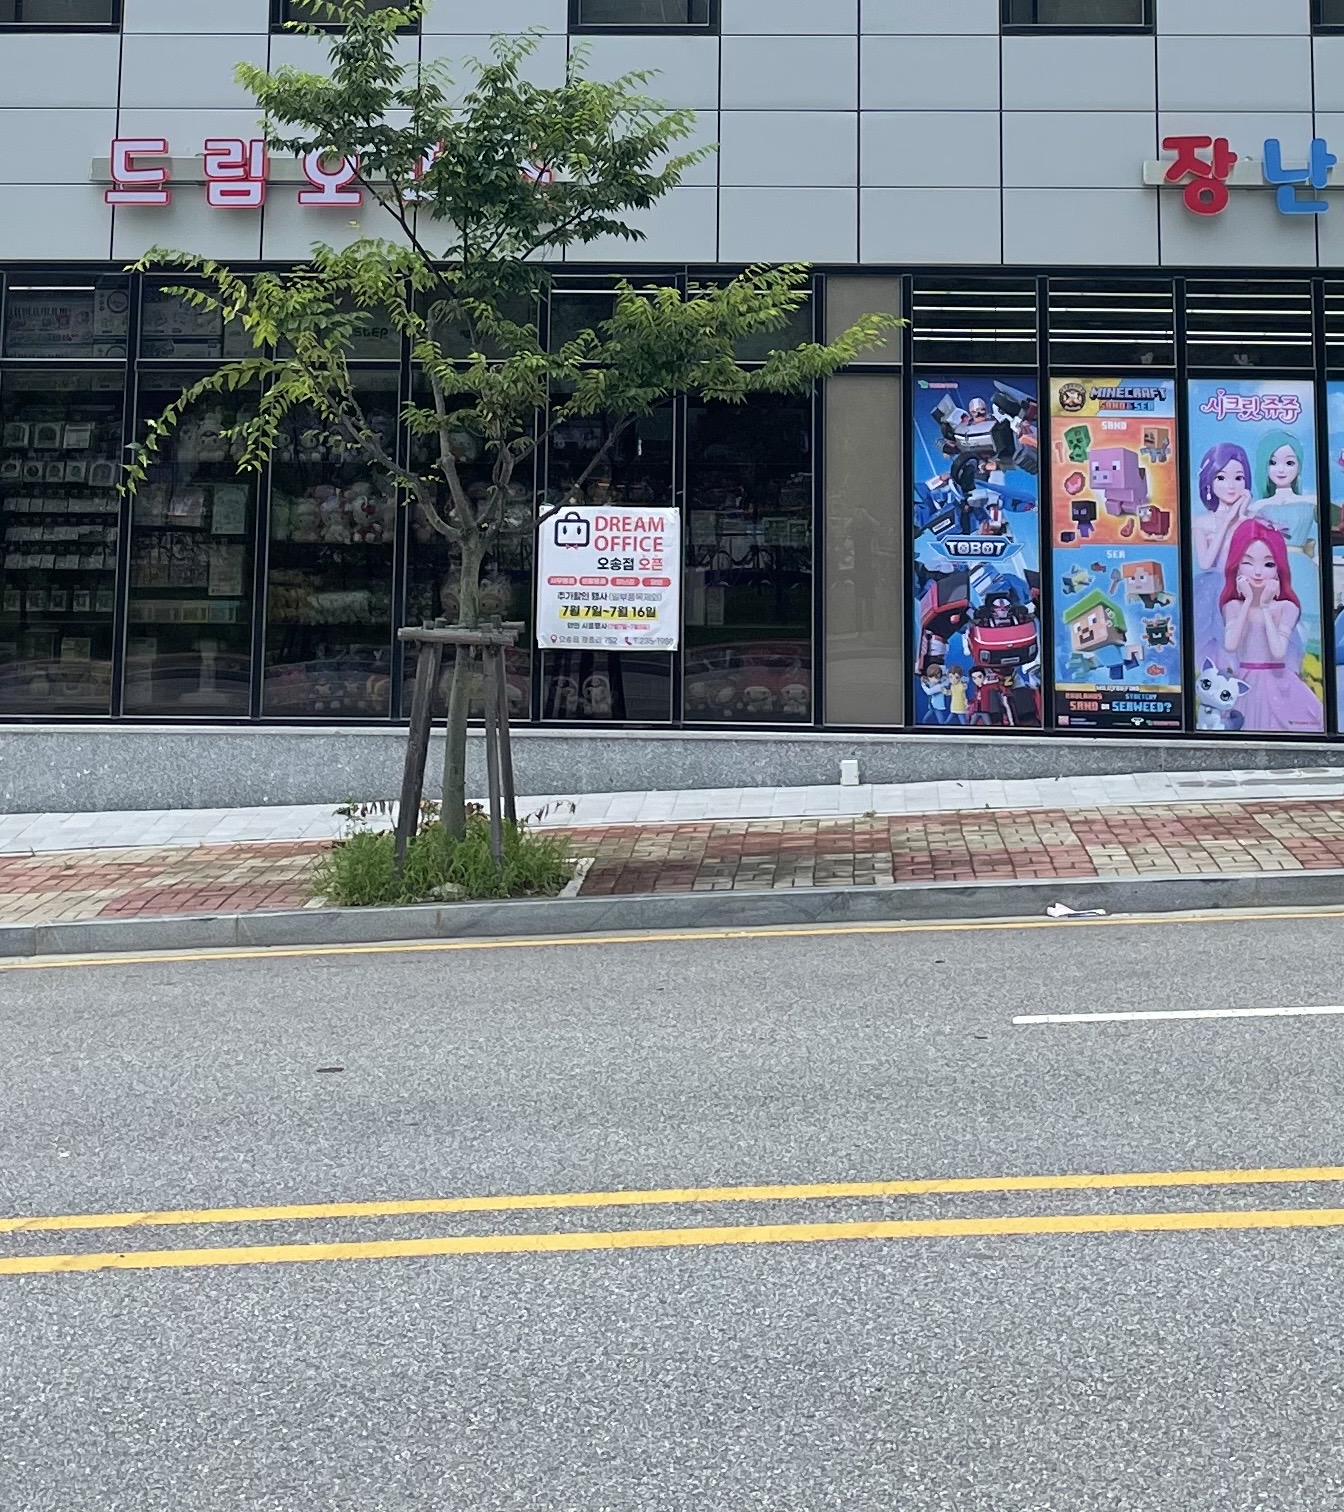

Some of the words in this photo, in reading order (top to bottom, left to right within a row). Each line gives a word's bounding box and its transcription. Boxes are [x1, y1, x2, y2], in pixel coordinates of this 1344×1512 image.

[104, 138, 556, 209] 드림오
[1089, 387, 1167, 401] MINECRAFT
[1101, 421, 1128, 430] SAND
[594, 516, 665, 533] DREAM
[594, 535, 664, 553] OFFICE
[945, 541, 1006, 556] TOBOT
[596, 557, 634, 571] 오송점
[638, 556, 664, 571] 오픈
[561, 605, 581, 617] 7월
[583, 605, 628, 618] 7일~7월
[631, 606, 656, 618] 16일
[1111, 701, 1172, 713] SEAWEED?
